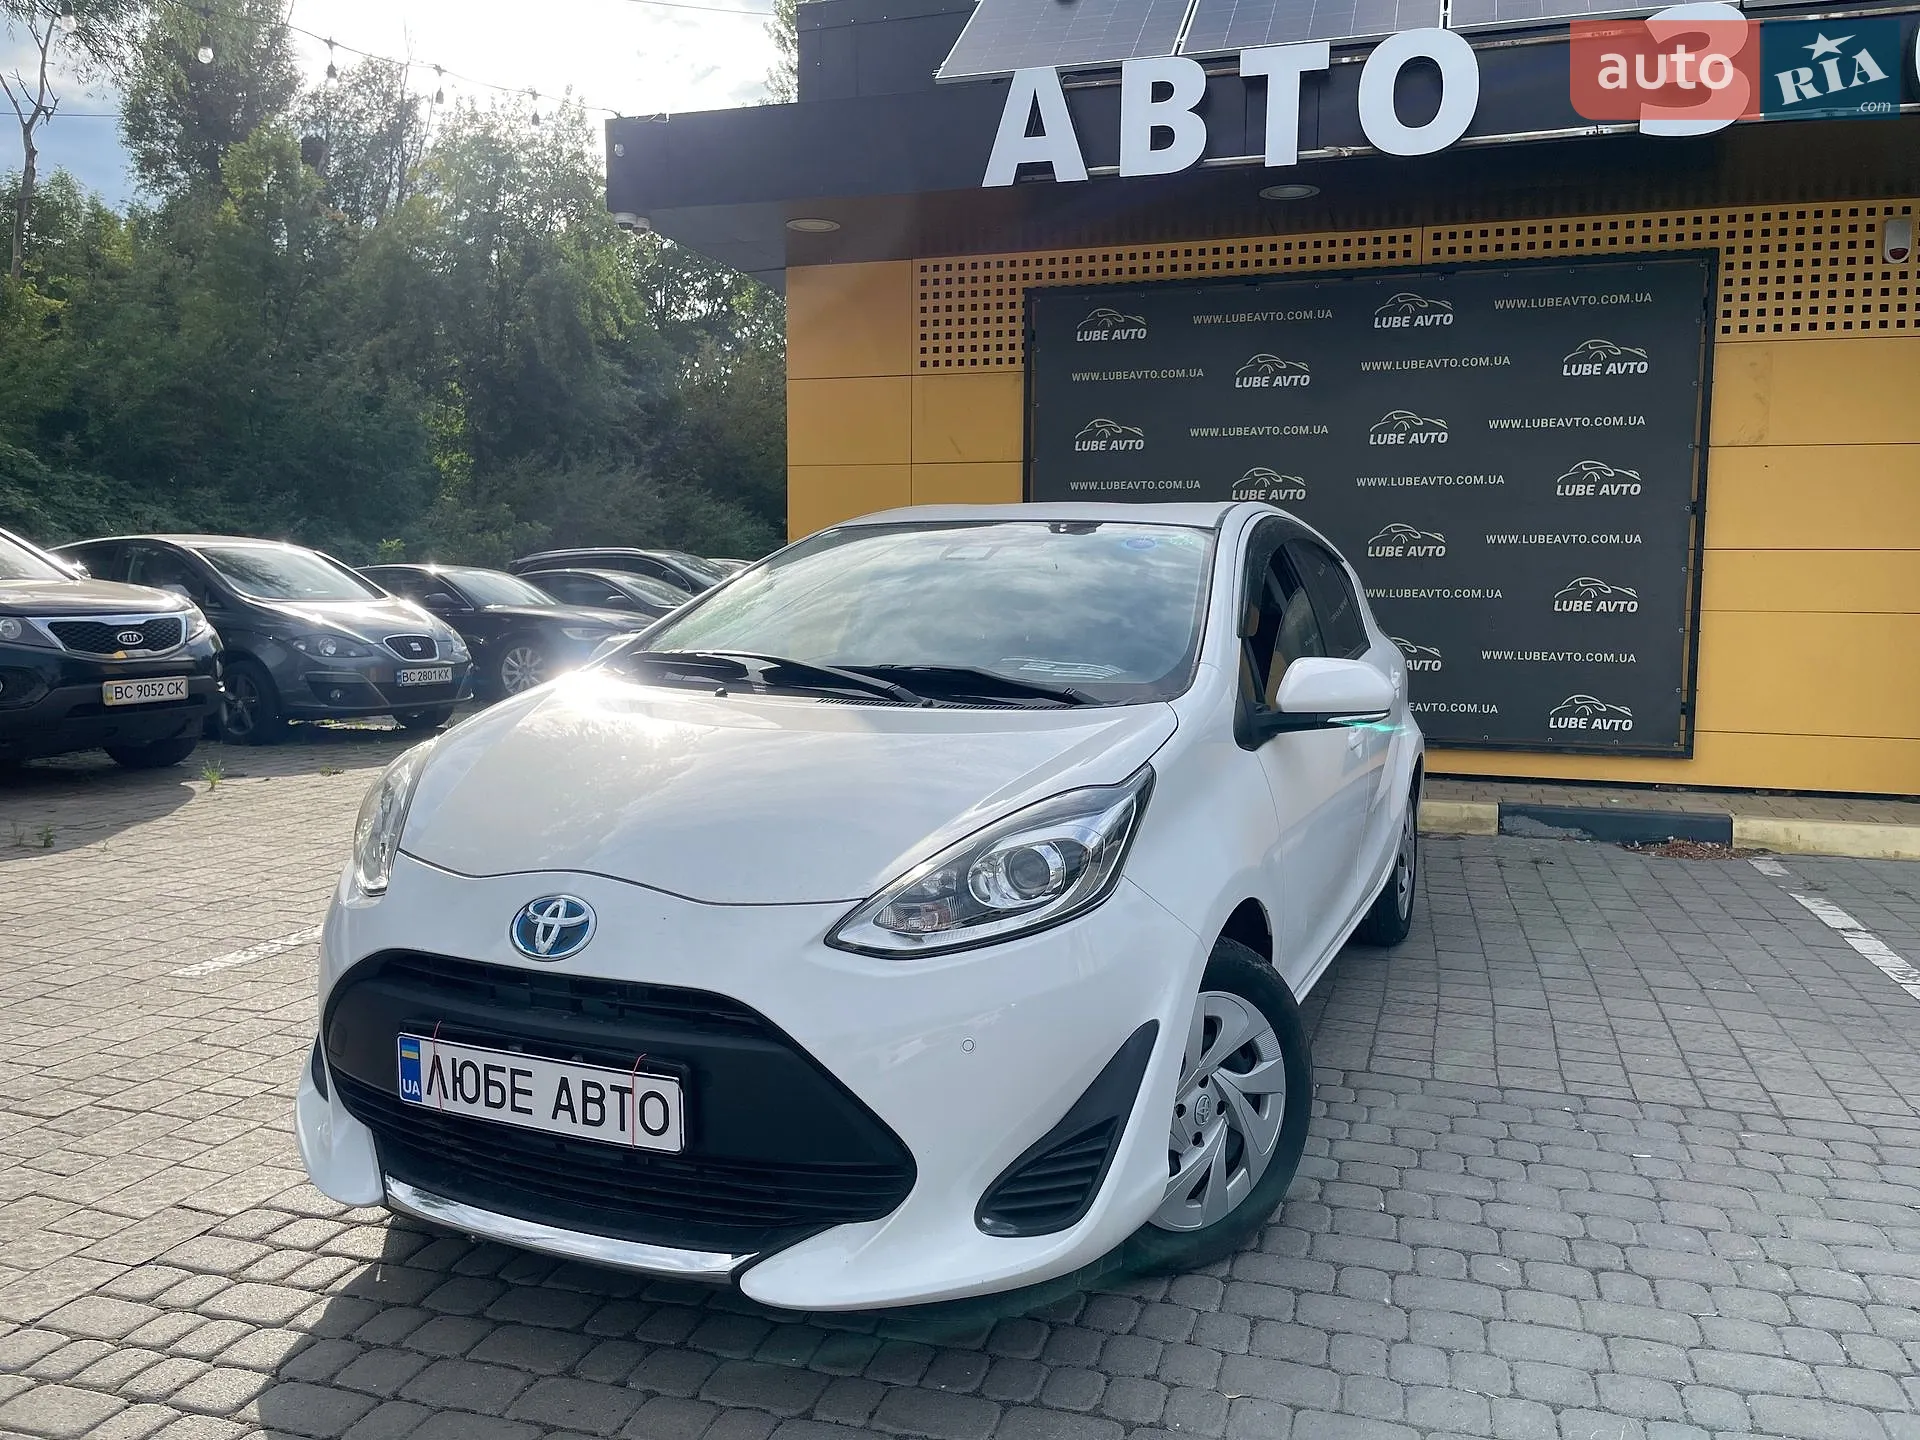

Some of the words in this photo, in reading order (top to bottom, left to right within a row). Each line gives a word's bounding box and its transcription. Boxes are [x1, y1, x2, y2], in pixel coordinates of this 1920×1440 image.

[982, 28, 1480, 187] АВТО
[1494, 292, 1653, 310] WWW.LUBEAVTO.COM.UA
[1192, 309, 1333, 325] WWW.LUBEAVTO.COM.UA
[1373, 315, 1411, 329] LUBE
[1413, 313, 1454, 327] AVTO
[1076, 329, 1110, 342] LUBE
[1111, 327, 1147, 341] AVTO
[1360, 355, 1511, 371] WWW.LUBEAVTO.COM.UA
[1562, 362, 1603, 376] LUBE
[1605, 360, 1649, 375] AVTO
[1071, 368, 1204, 382] WWW.LUBEAVTO.COM.UA
[1235, 376, 1271, 388] LUBE
[1272, 374, 1310, 387] AVTO
[1488, 415, 1646, 429] WWW.LUBEAVTO.COM.UA
[1189, 424, 1329, 437] WWW.LUBEAVTO.COM.UA
[1074, 438, 1108, 451] LUBE
[1109, 438, 1145, 451] AVTO
[1369, 432, 1406, 445] LUBE
[1408, 431, 1449, 444] AVTO
[1069, 479, 1201, 491] WWW.LUBEAVTO.COM.UA
[1356, 474, 1505, 487] WWW.LUBEAVTO.COM.UA
[1231, 488, 1267, 501] LUBE
[1268, 488, 1306, 500] AVTO
[1556, 483, 1596, 496] LUBE
[1598, 482, 1642, 496] AVTO
[1486, 533, 1642, 545] WWW.LUBEAVTO.COM.UA
[1367, 545, 1404, 557] LUBE
[1406, 545, 1446, 557] AVTO
[1364, 588, 1503, 599] WW.LUBEAVTO.COM.UA
[1553, 600, 1593, 612] LUBE
[1595, 600, 1639, 613] AVTO
[121, 633, 140, 643] KIA
[1481, 649, 1637, 664] WWW.LUBEAVTO.COM.UA
[417, 670, 437, 681] 2801
[136, 682, 164, 699] 9052
[1549, 716, 1589, 730] LUBE
[1590, 717, 1633, 731] AVTO
[402, 1078, 421, 1096] UA
[426, 1054, 533, 1116] ЛЮБЕ
[551, 1076, 670, 1137] АВТО
